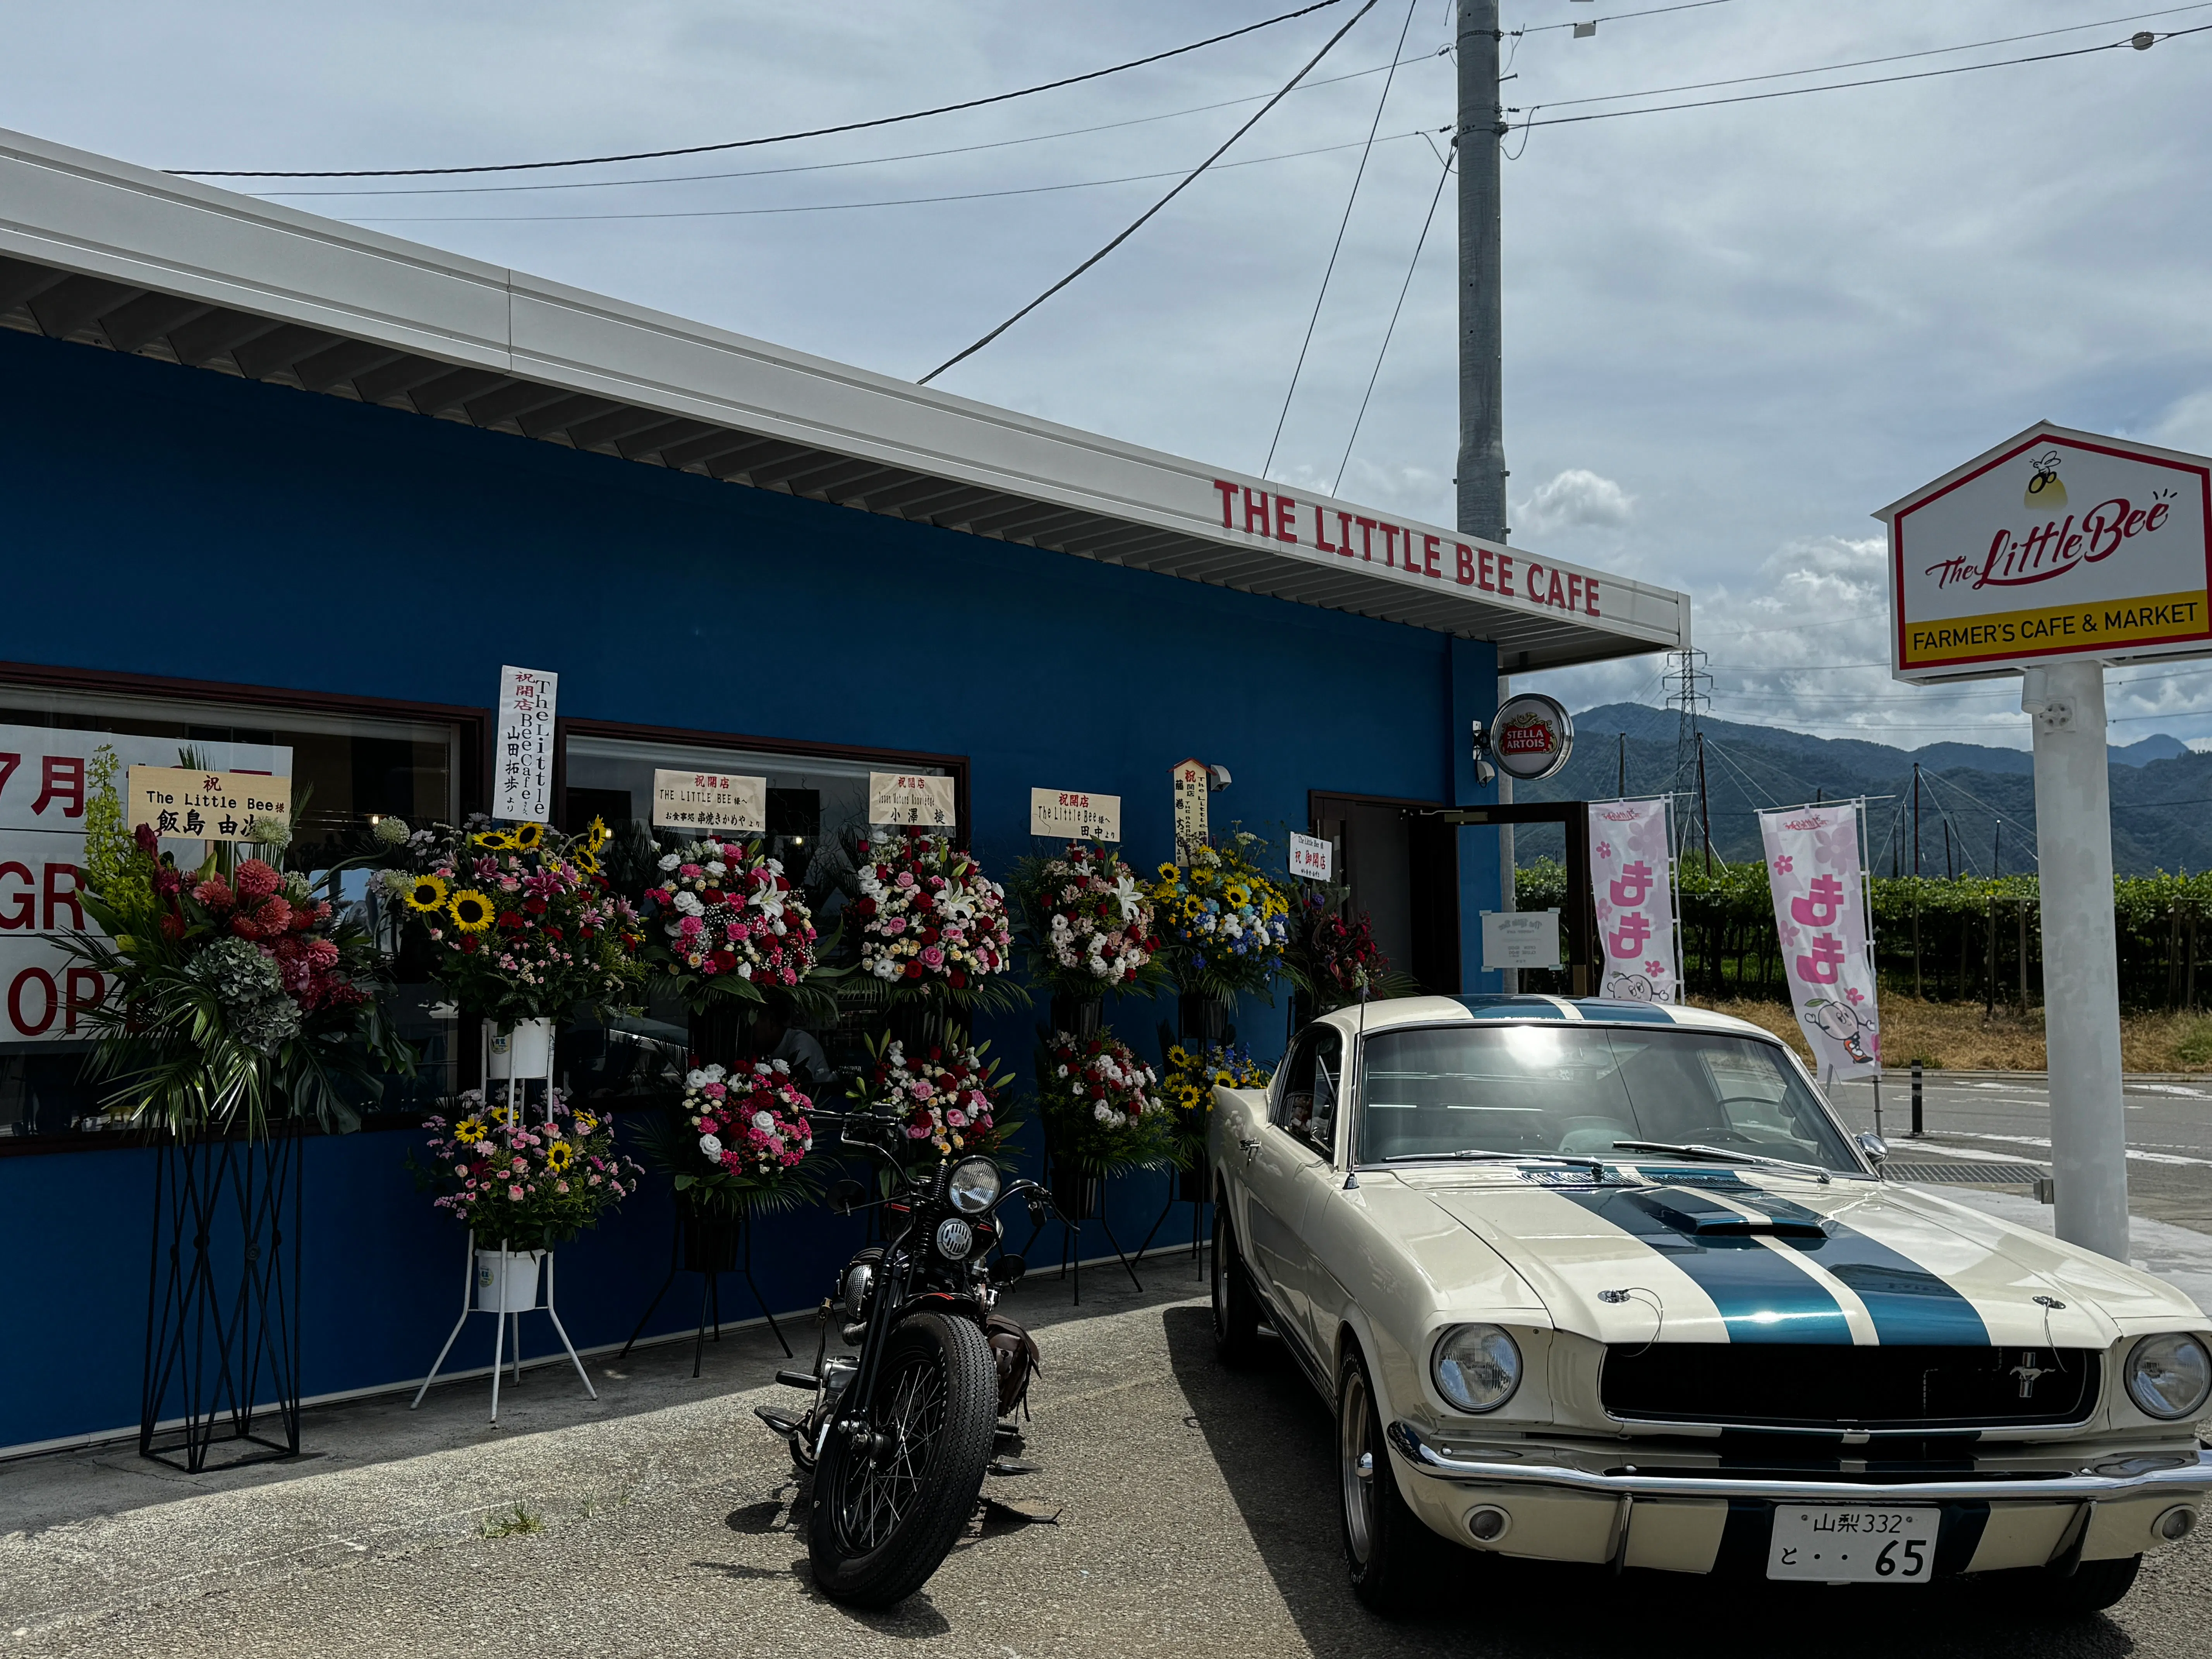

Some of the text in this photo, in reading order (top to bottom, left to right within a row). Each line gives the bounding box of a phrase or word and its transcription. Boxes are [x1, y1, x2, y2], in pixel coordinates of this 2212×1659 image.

[1214, 480, 1600, 617] THE LITTLE BEE CAFE
[1925, 555, 1974, 589] The
[2082, 498, 2170, 562] Bee
[1913, 603, 2198, 651] FARMER'S CAFE & MARKET
[513, 671, 536, 711] 祝開店
[1507, 729, 1544, 739] STELLA
[1507, 738, 1545, 749] ARTOIS
[505, 726, 520, 793] 山田拓歩
[203, 775, 222, 792] 祝
[694, 775, 730, 789] 祝開店
[898, 777, 925, 789] 祝開店
[1185, 769, 1196, 783] 祝
[146, 791, 174, 805] The
[185, 793, 237, 809] Little
[247, 798, 274, 812] Bee
[660, 789, 674, 800] THE
[681, 790, 711, 802] LITTLE
[717, 793, 732, 804] BEE
[1058, 793, 1089, 808] 祝開店
[156, 809, 206, 836] 飯島
[665, 812, 695, 822] お食事処
[1038, 806, 1051, 819] The
[1054, 807, 1081, 821] Little
[1084, 810, 1097, 823] Bee
[1081, 826, 1103, 838] 田中
[1781, 1540, 1927, 1577] と 65
